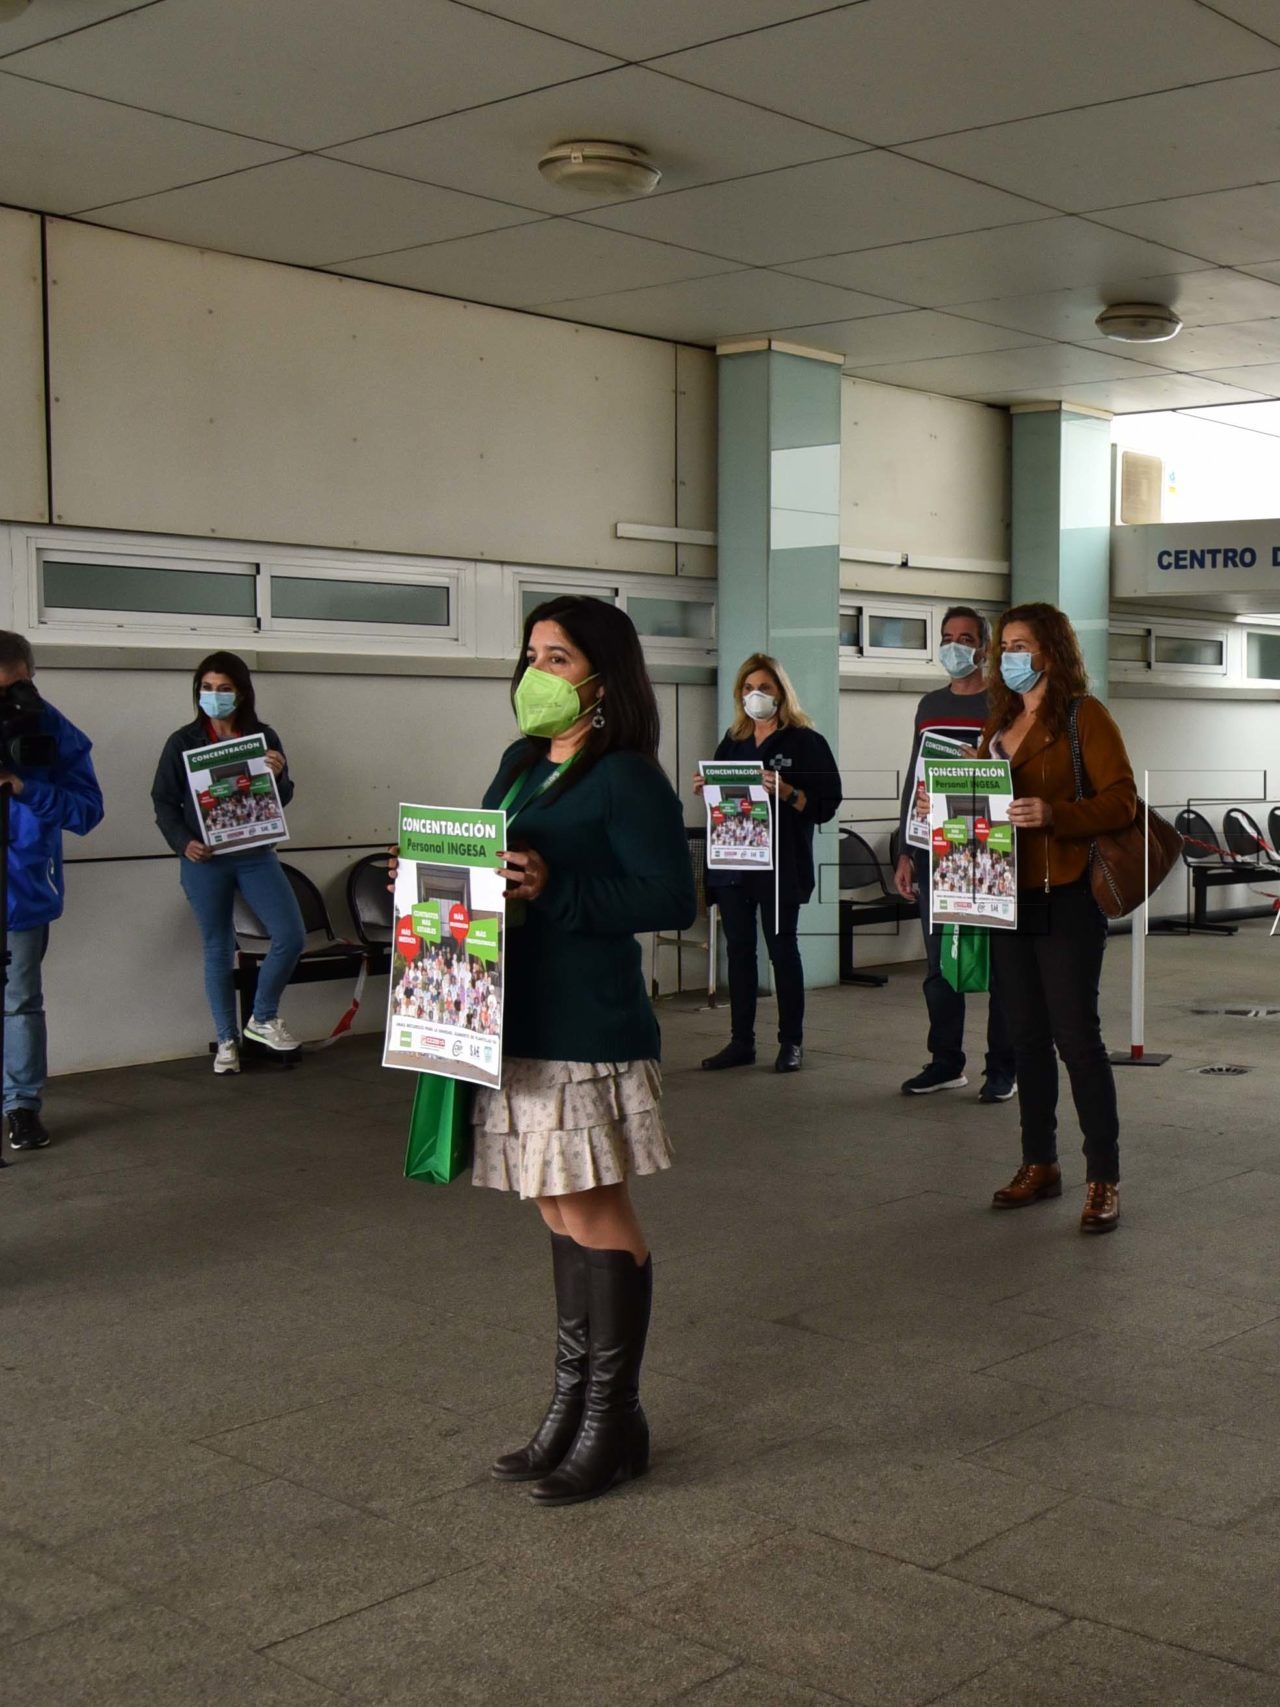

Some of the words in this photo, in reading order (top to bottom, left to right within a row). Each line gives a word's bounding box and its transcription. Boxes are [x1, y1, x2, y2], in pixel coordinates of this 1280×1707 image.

[1157, 547, 1256, 570] CENTRO
[402, 817, 496, 839] CONCENTRACIÓN
[407, 838, 444, 853] Personal
[447, 843, 487, 857] INGESA
